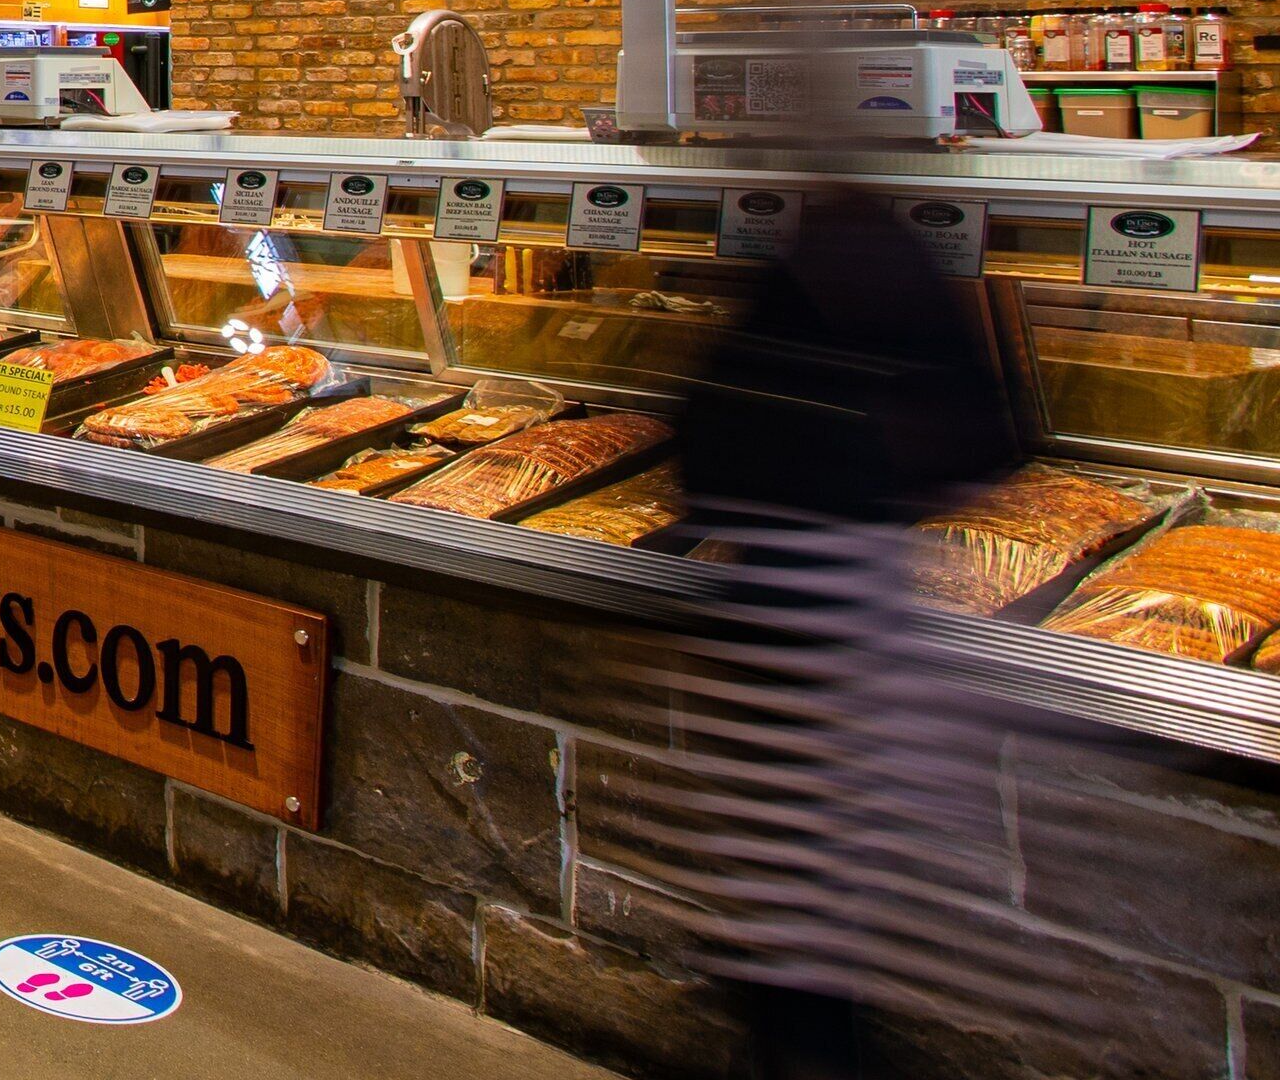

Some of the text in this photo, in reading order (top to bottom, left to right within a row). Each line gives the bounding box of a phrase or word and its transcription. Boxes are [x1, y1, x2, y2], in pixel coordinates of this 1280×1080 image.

[1199, 31, 1217, 42] Rc
[333, 197, 379, 206] ANDOUILLE
[336, 206, 373, 215] SAUSAGE
[935, 231, 969, 240] BOAR
[1128, 239, 1157, 249] HOT
[1091, 248, 1192, 261] ITALIAN SAUSAGE
[1117, 268, 1162, 279] $10.00/LB
[9, 366, 46, 382] SPECIAL
[23, 389, 47, 400] STEAK
[5, 405, 36, 418] $15.00
[98, 953, 136, 972] 2m
[78, 963, 114, 981] 6ft
